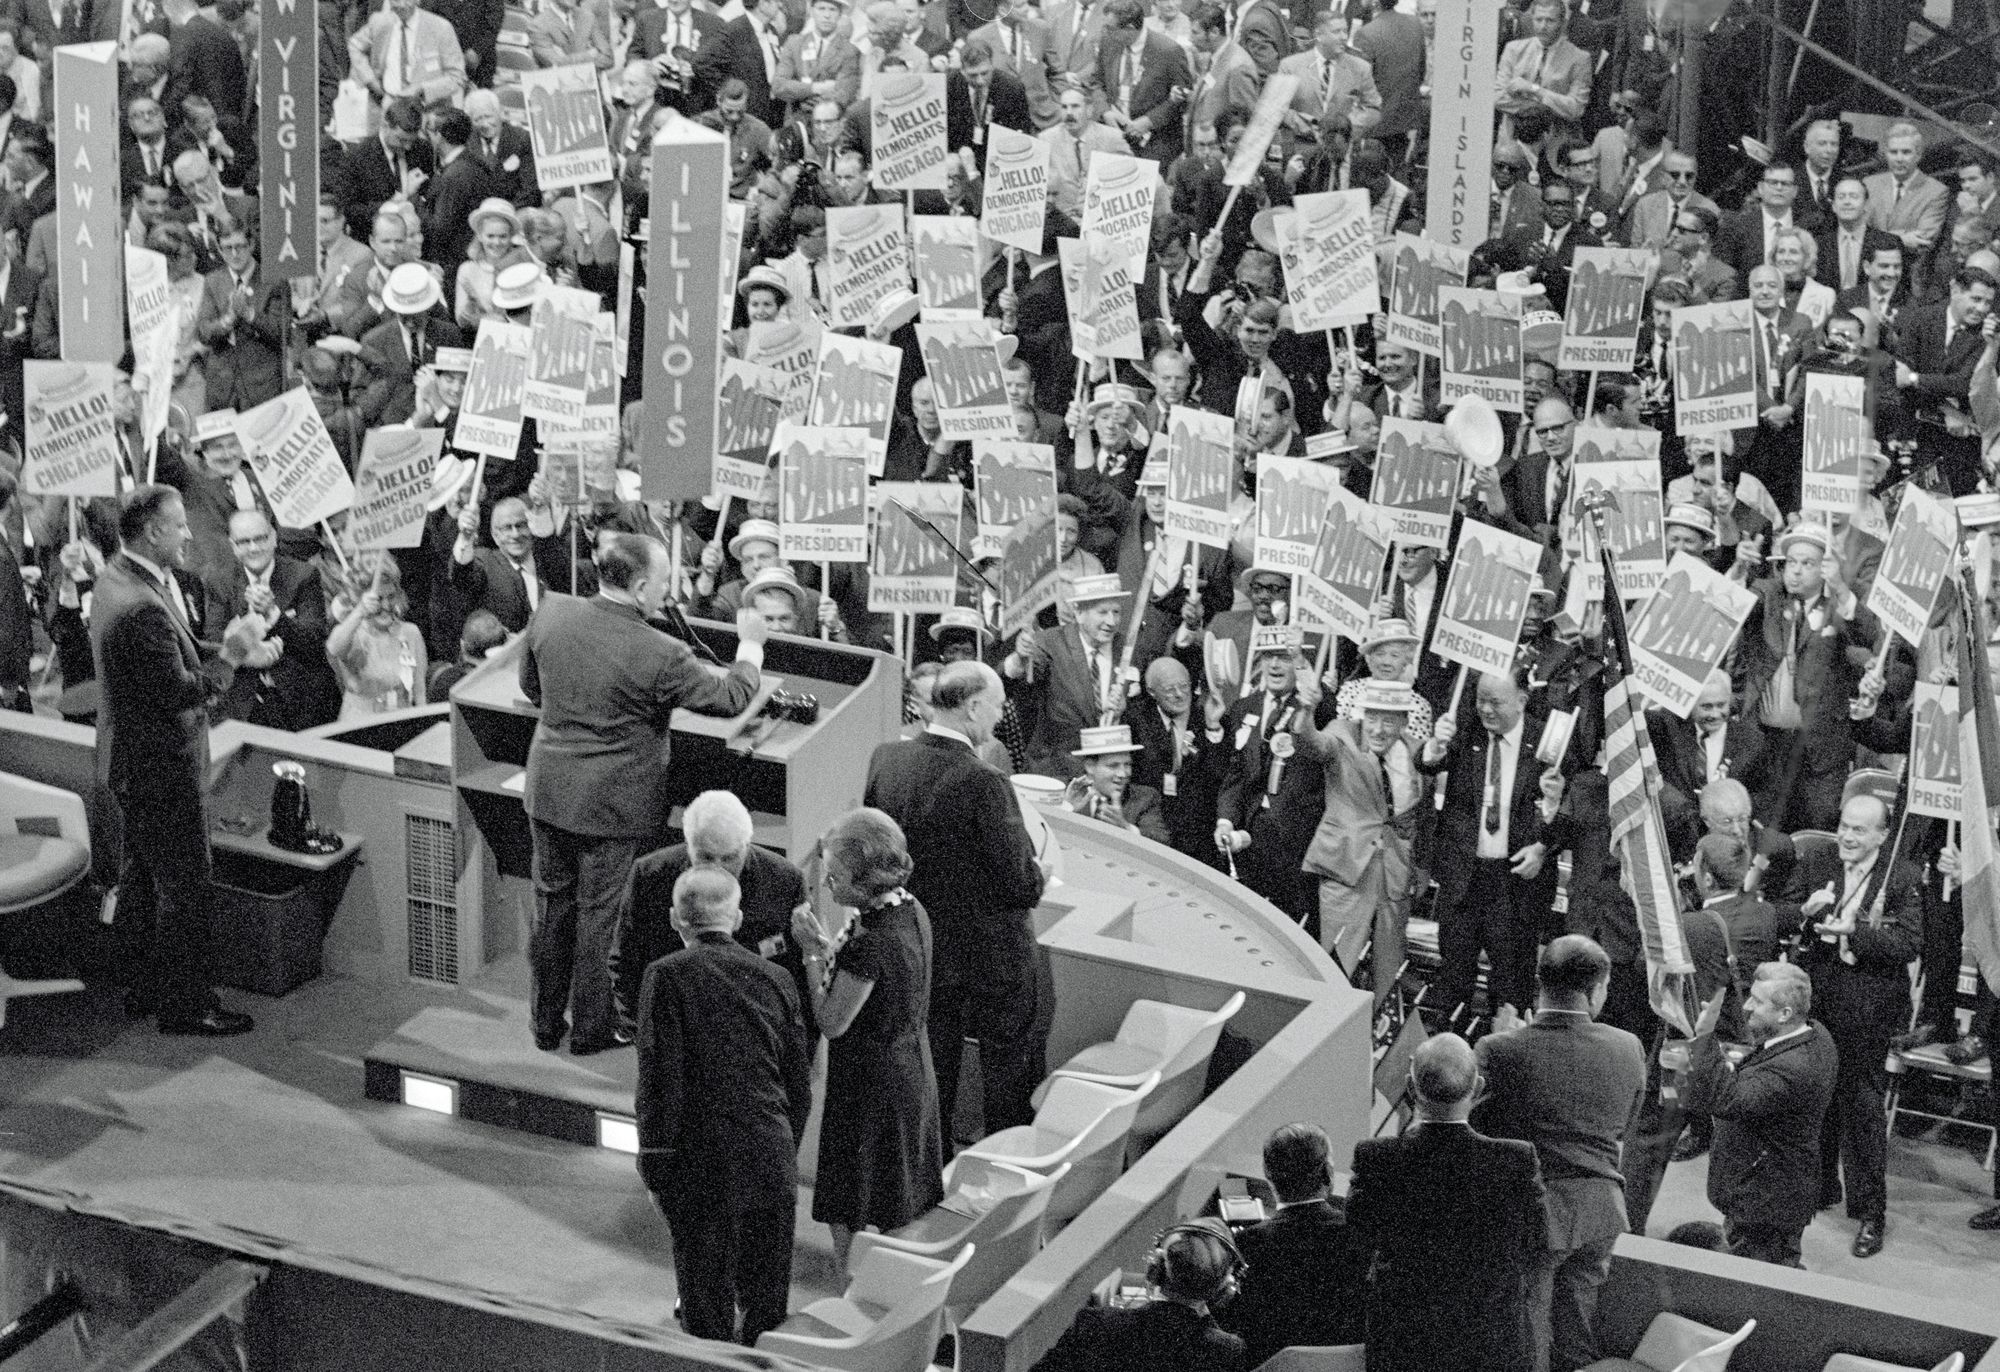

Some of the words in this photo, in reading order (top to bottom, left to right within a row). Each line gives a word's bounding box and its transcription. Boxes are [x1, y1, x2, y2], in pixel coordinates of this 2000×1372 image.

[1459, 0, 1474, 98] IRGIN
[890, 98, 946, 135] HELLO!
[273, 36, 299, 263] VIRGINIA
[875, 120, 945, 160] DEMOCRATS
[541, 159, 607, 180] PRESIDENT
[880, 145, 946, 186] CHICAGO
[1001, 165, 1047, 190] HELLO!
[1452, 116, 1468, 245] ISLANDS
[74, 102, 94, 324] HAWAII
[985, 187, 1045, 210] DEMOCRATS
[1101, 187, 1153, 220] HELLO!
[987, 211, 1042, 235] CHICAGO
[849, 231, 903, 270] HELLO!
[833, 252, 904, 297] DEMOCRATS
[1313, 266, 1374, 314] CHICAGO
[661, 162, 693, 447] ILLINOIS
[1565, 346, 1634, 363] PRESIDENT
[48, 393, 112, 432] HELLO!
[526, 391, 582, 416] PRESIDENT
[1680, 403, 1754, 427] PRESIDENT
[29, 418, 112, 461] DEMOCRATS
[271, 415, 323, 471] HELLO!
[459, 424, 517, 450] PRESIDENT
[943, 415, 1013, 433] PRESIDENT
[35, 448, 113, 489] CHICAGO
[269, 436, 331, 505] DEMOCRATS
[376, 455, 436, 493] HELLO!
[285, 461, 344, 524] CHICAGO
[353, 478, 433, 519] DEMOCRATS
[1805, 483, 1858, 503] PRESIDENT
[352, 502, 425, 546] CHICAGO
[784, 534, 863, 553] PRESIDENT
[1168, 511, 1226, 537] PRESIDENT
[1259, 547, 1310, 568] PRESID
[873, 588, 951, 604] PRESIDENT
[1307, 583, 1365, 634] PRESIDENT
[1872, 586, 1924, 636] PRESIDENT
[1436, 629, 1511, 669] PRESIDENT
